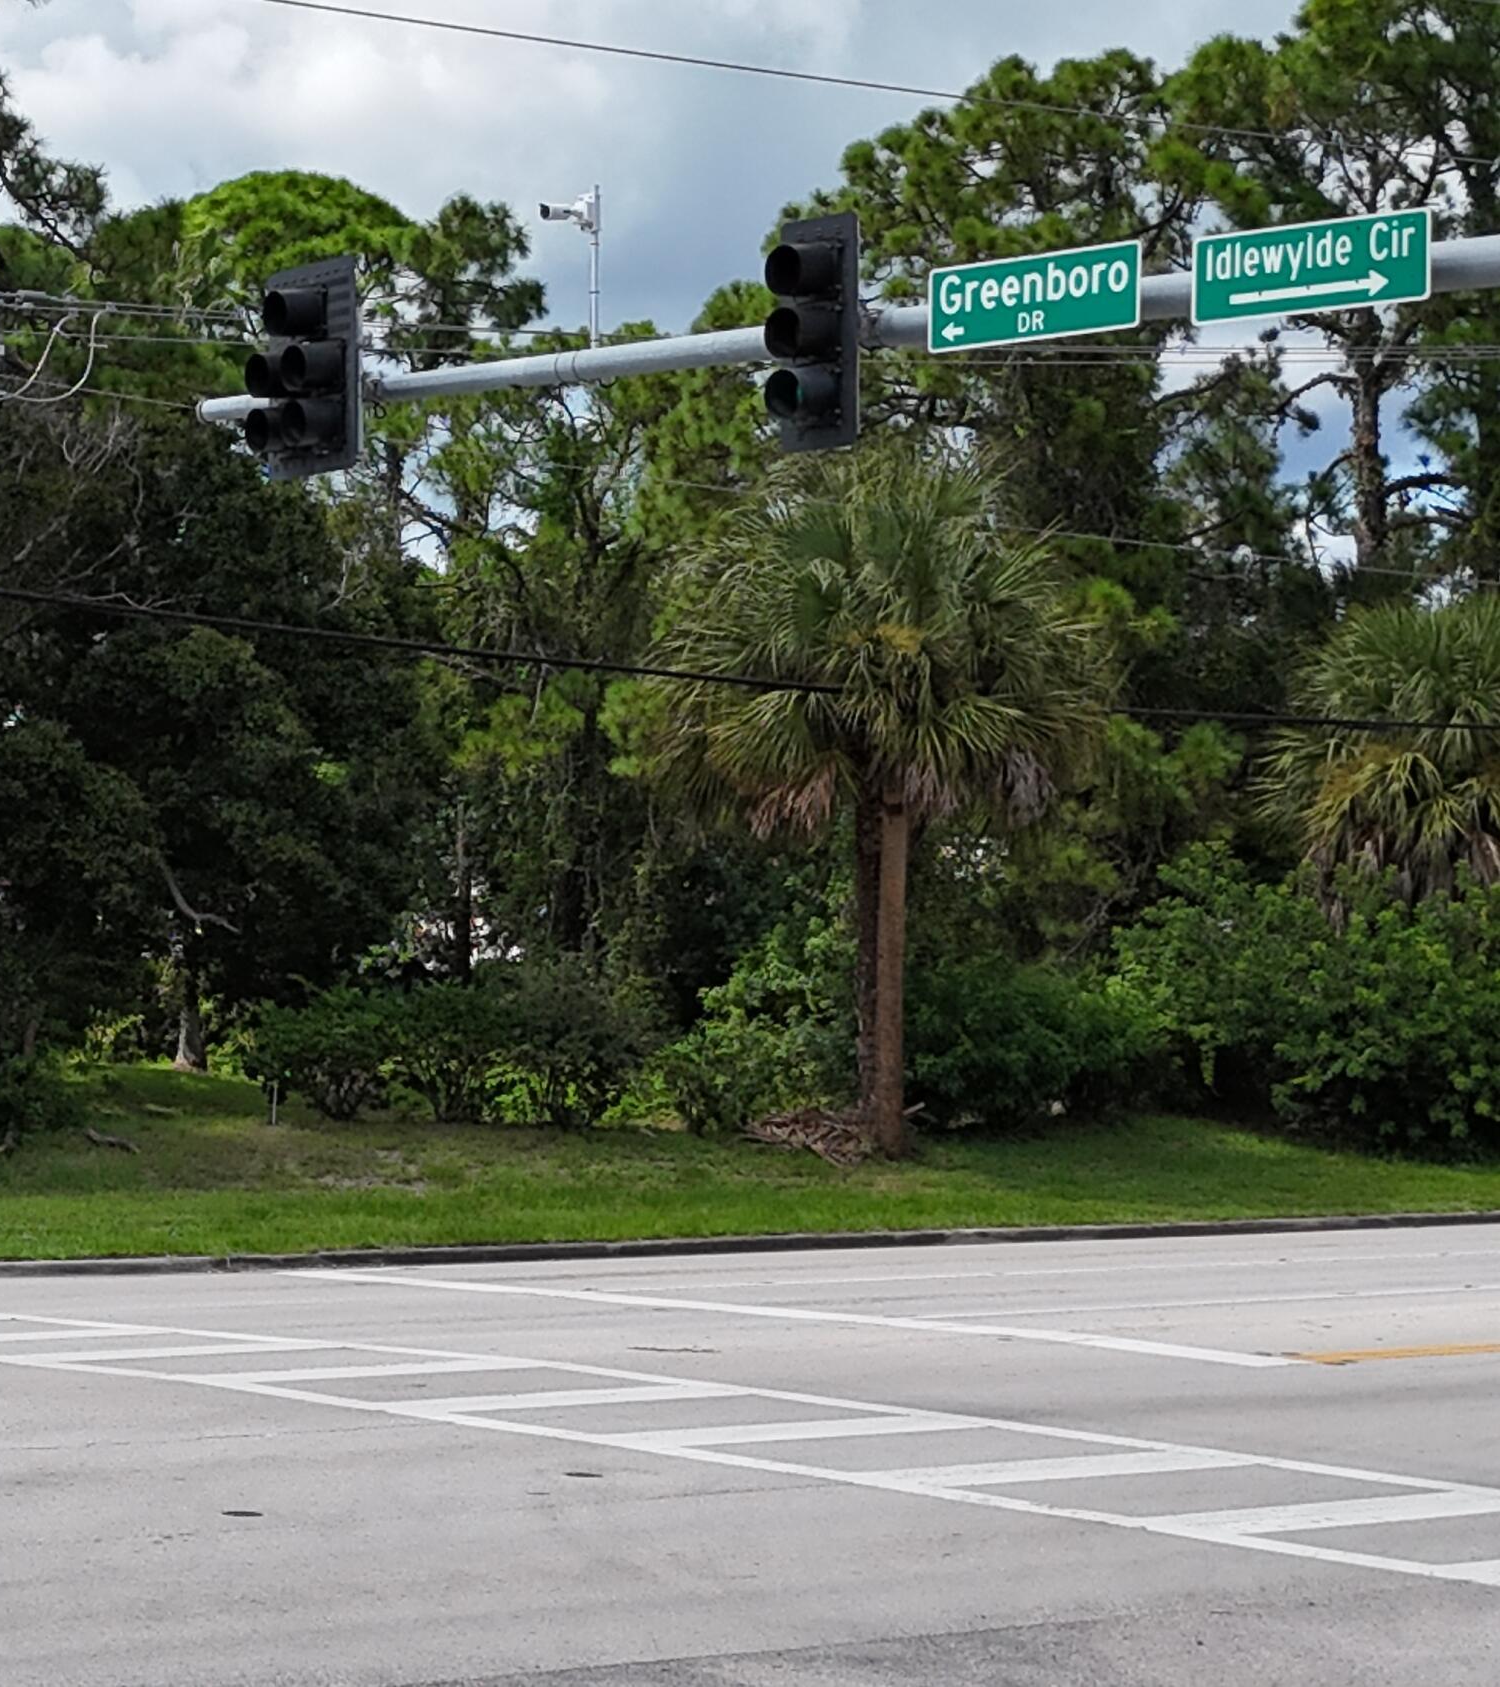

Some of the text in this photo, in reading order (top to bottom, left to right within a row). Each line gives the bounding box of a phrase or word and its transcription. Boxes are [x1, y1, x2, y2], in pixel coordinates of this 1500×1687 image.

[1205, 219, 1416, 282] Idlewylde Cir
[939, 259, 1130, 316] Greenboro
[1016, 309, 1046, 334] DR
